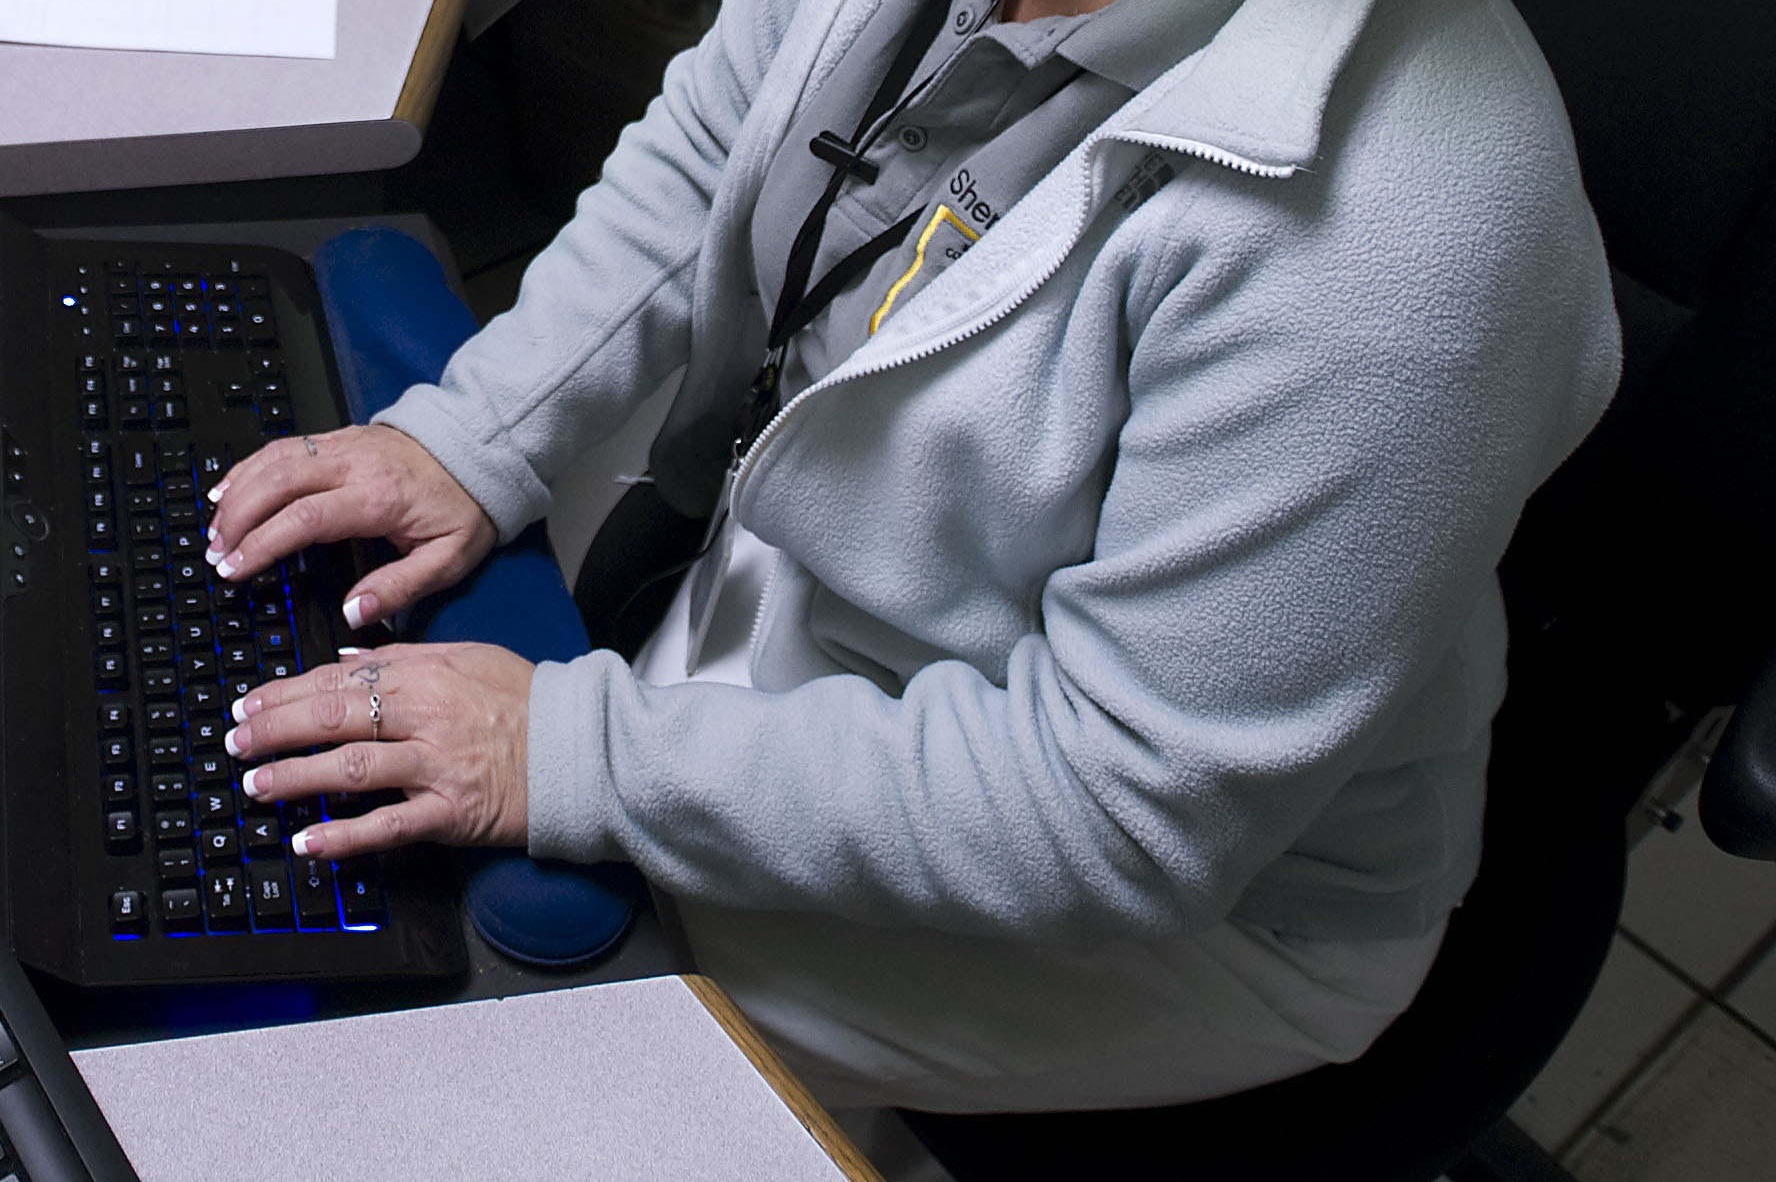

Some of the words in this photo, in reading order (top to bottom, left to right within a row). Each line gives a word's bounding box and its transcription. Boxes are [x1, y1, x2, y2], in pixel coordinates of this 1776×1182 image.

[179, 536, 190, 547] P
[182, 566, 194, 577] O
[189, 627, 201, 638] U
[232, 650, 244, 661] H
[193, 659, 205, 670] Y
[197, 692, 209, 703] T
[200, 726, 212, 736] R
[204, 761, 217, 772] E
[210, 797, 223, 811] W
[256, 825, 268, 837] A
[213, 835, 227, 848] Q
[121, 896, 131, 914] Esc
